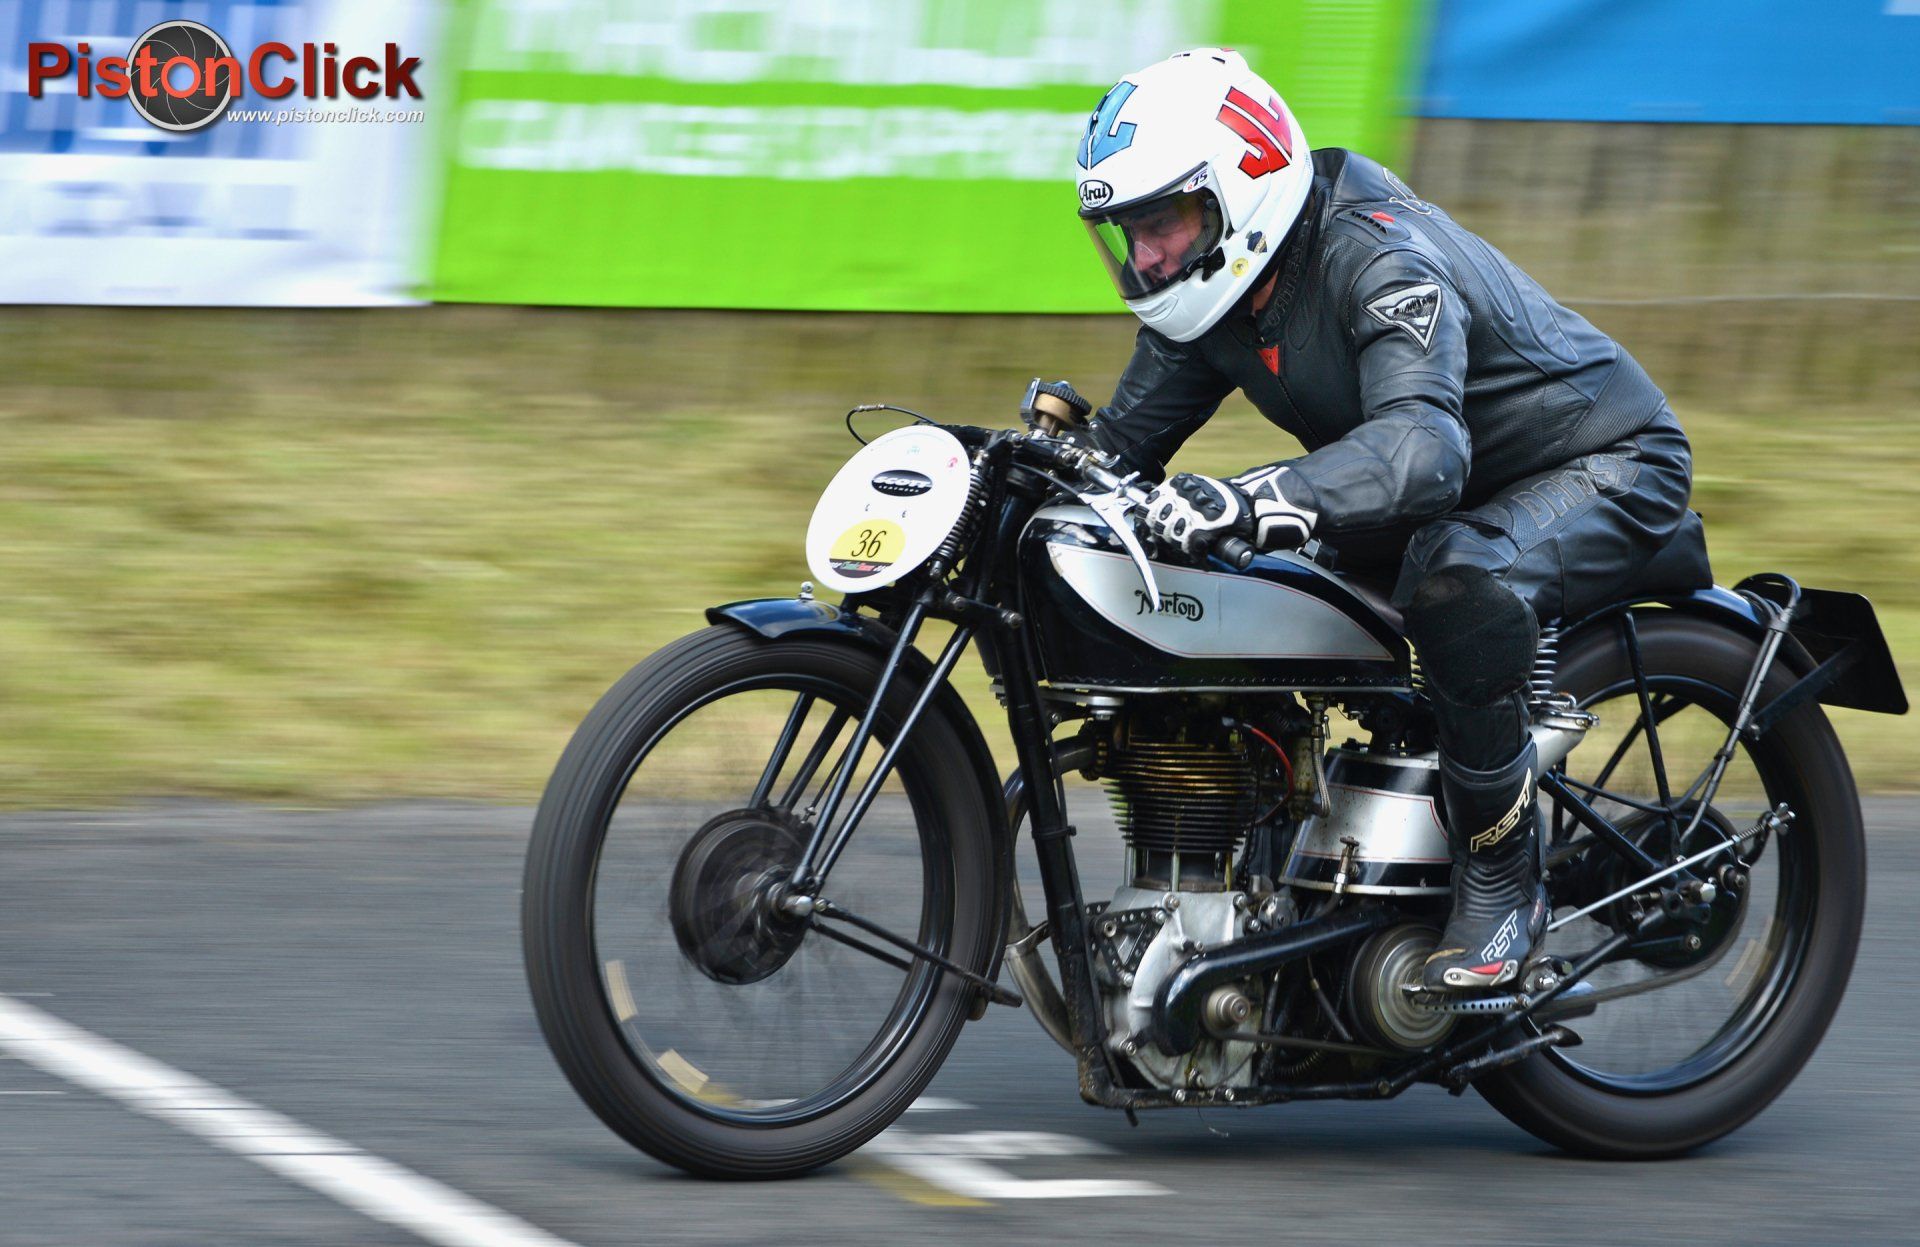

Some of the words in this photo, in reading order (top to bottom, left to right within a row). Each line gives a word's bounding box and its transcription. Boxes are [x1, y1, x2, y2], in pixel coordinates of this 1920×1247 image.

[1083, 183, 1107, 201] Arai
[851, 529, 887, 558] 36
[1134, 589, 1204, 622] Norton
[1470, 767, 1531, 853] RST
[1480, 908, 1519, 964] RST
